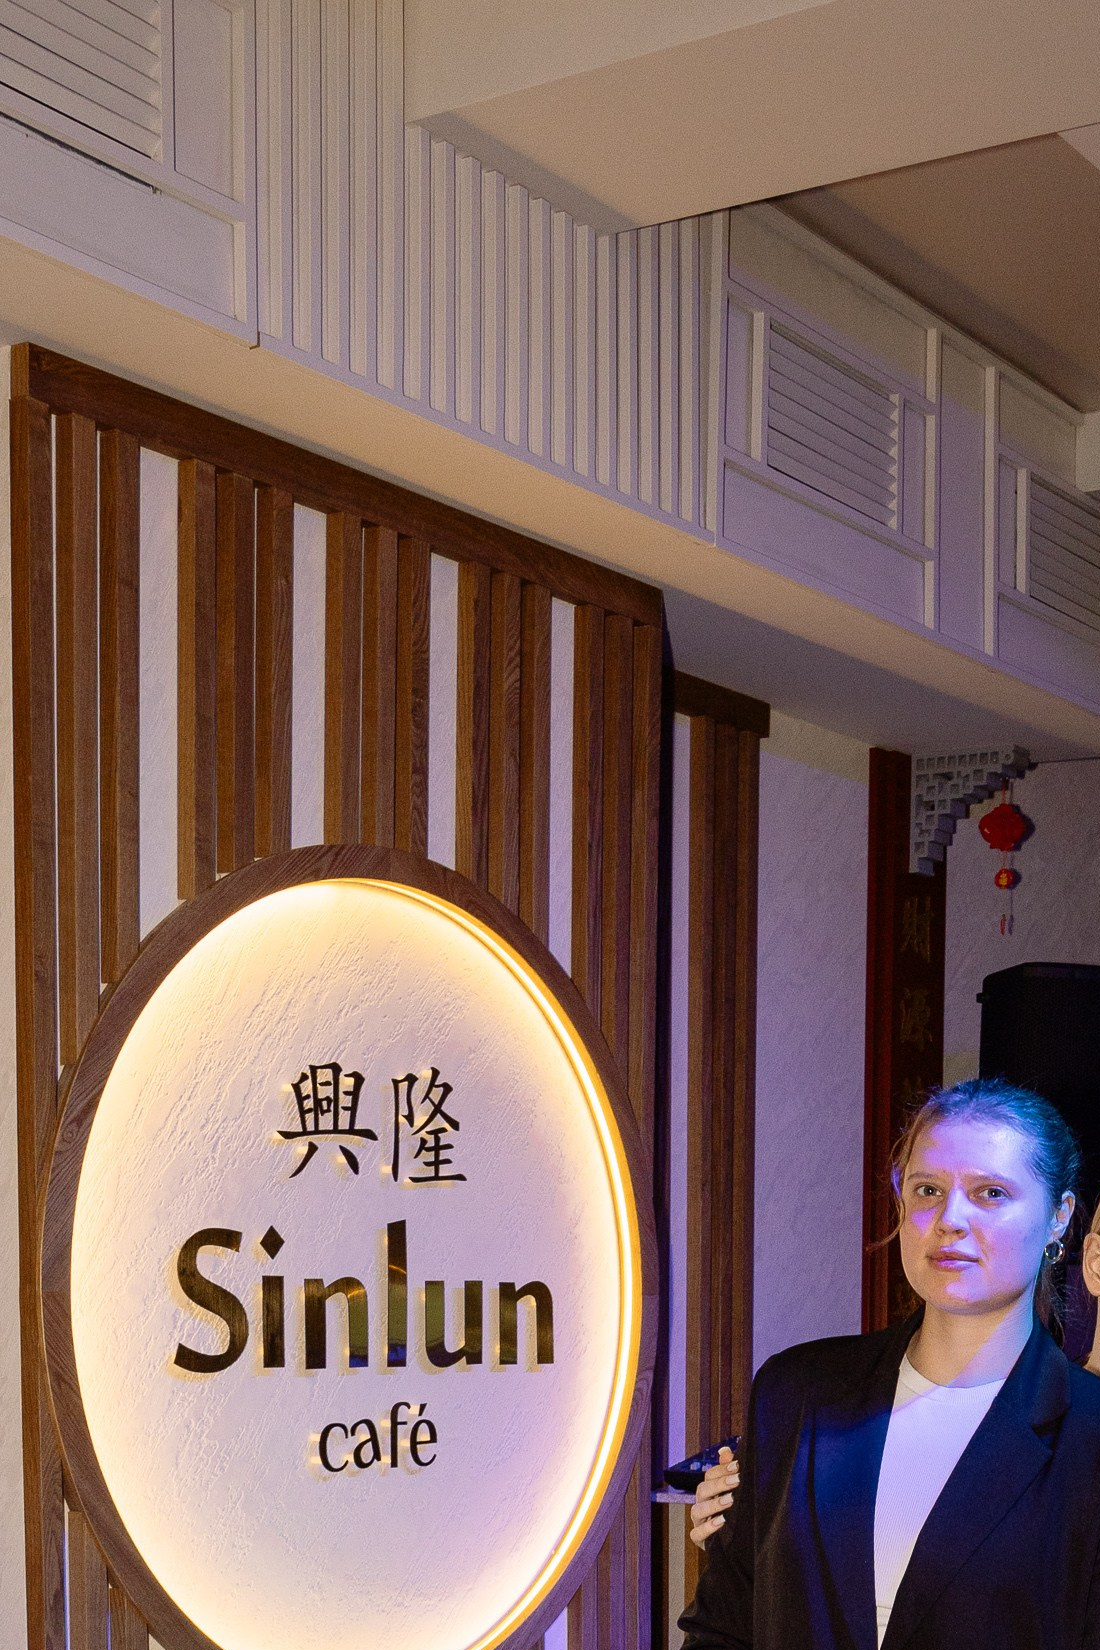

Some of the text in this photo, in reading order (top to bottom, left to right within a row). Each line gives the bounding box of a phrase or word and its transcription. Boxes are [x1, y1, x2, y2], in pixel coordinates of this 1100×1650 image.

[275, 1061, 468, 1183] 興隆
[173, 1219, 555, 1374] Sinlun
[318, 1401, 439, 1473] café
